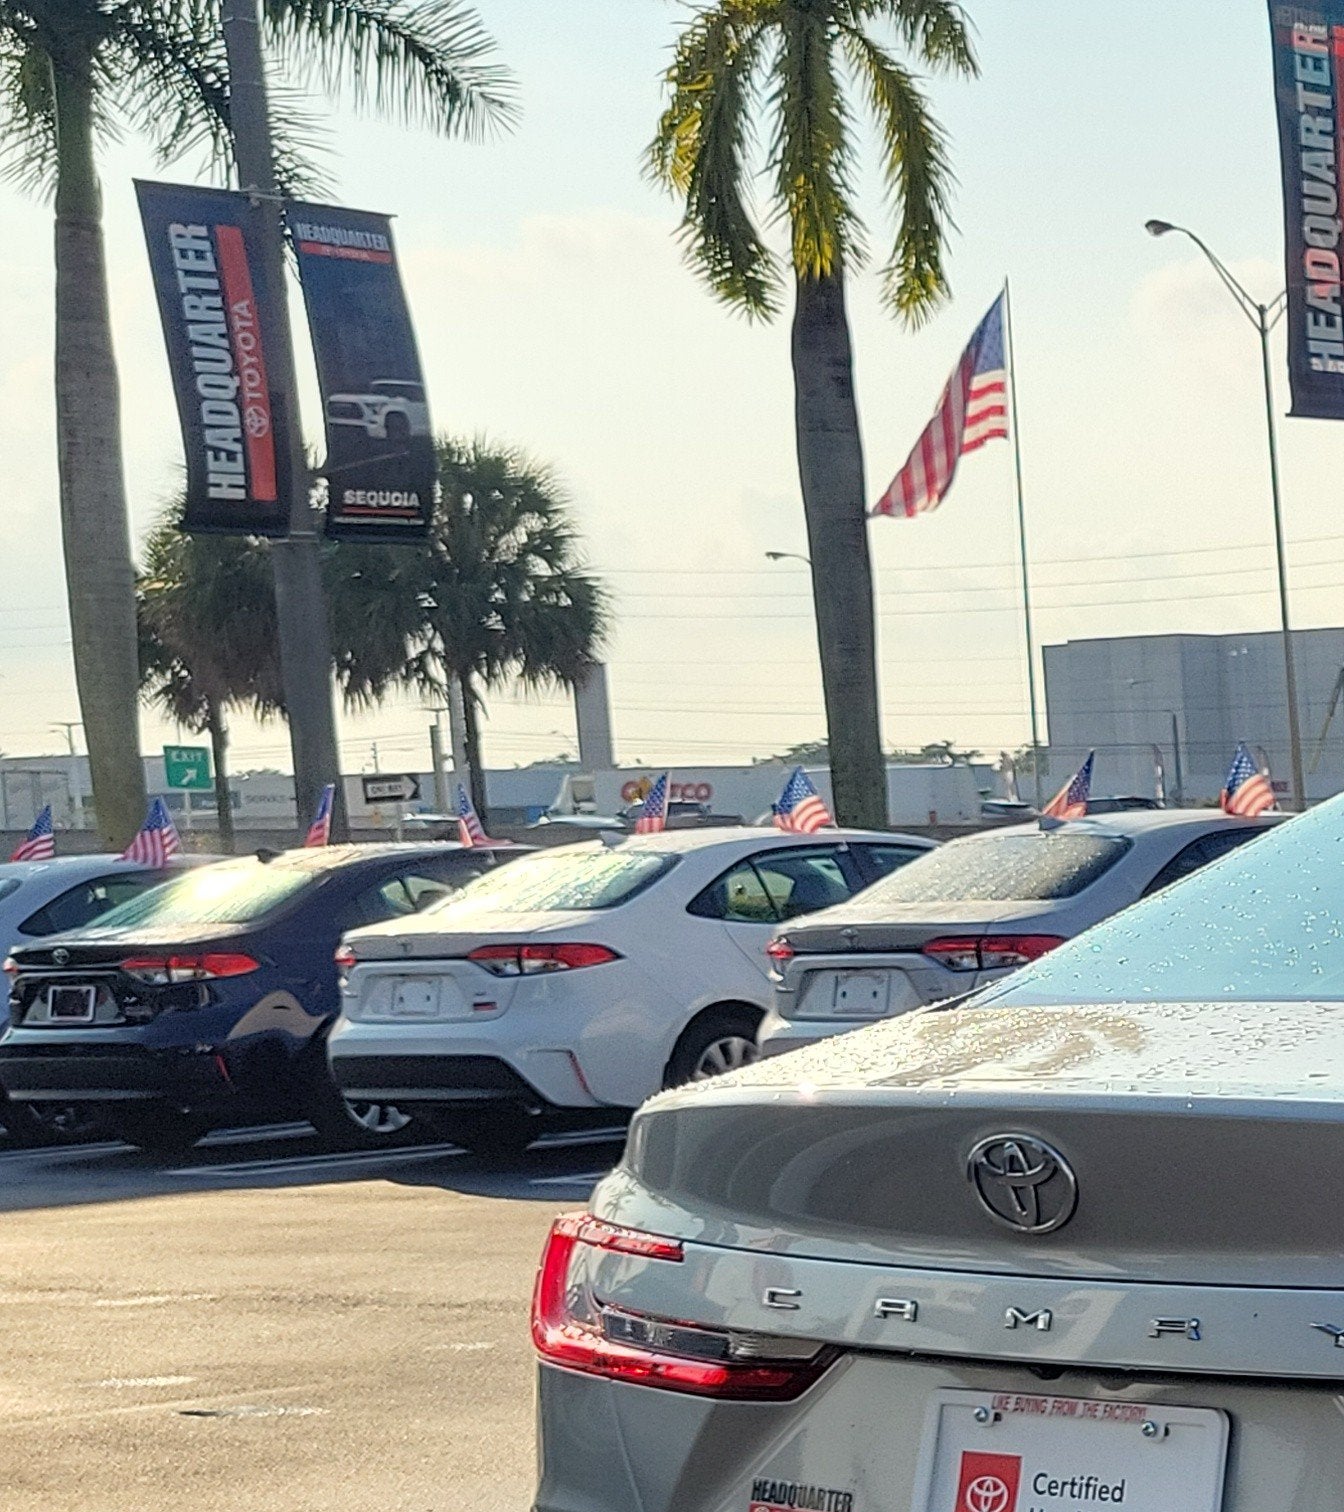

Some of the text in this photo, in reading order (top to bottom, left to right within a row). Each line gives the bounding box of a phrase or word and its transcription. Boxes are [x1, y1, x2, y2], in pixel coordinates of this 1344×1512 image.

[168, 222, 247, 501] HEADQUARTER
[231, 300, 262, 400] TOYOTA
[343, 488, 420, 508] SEQUOIA
[991, 1394, 1009, 1412] LIKE
[1013, 1396, 1047, 1415] BUYING
[1051, 1399, 1079, 1417] FROM
[1082, 1401, 1099, 1418] THE
[1033, 1472, 1126, 1503] Certified
